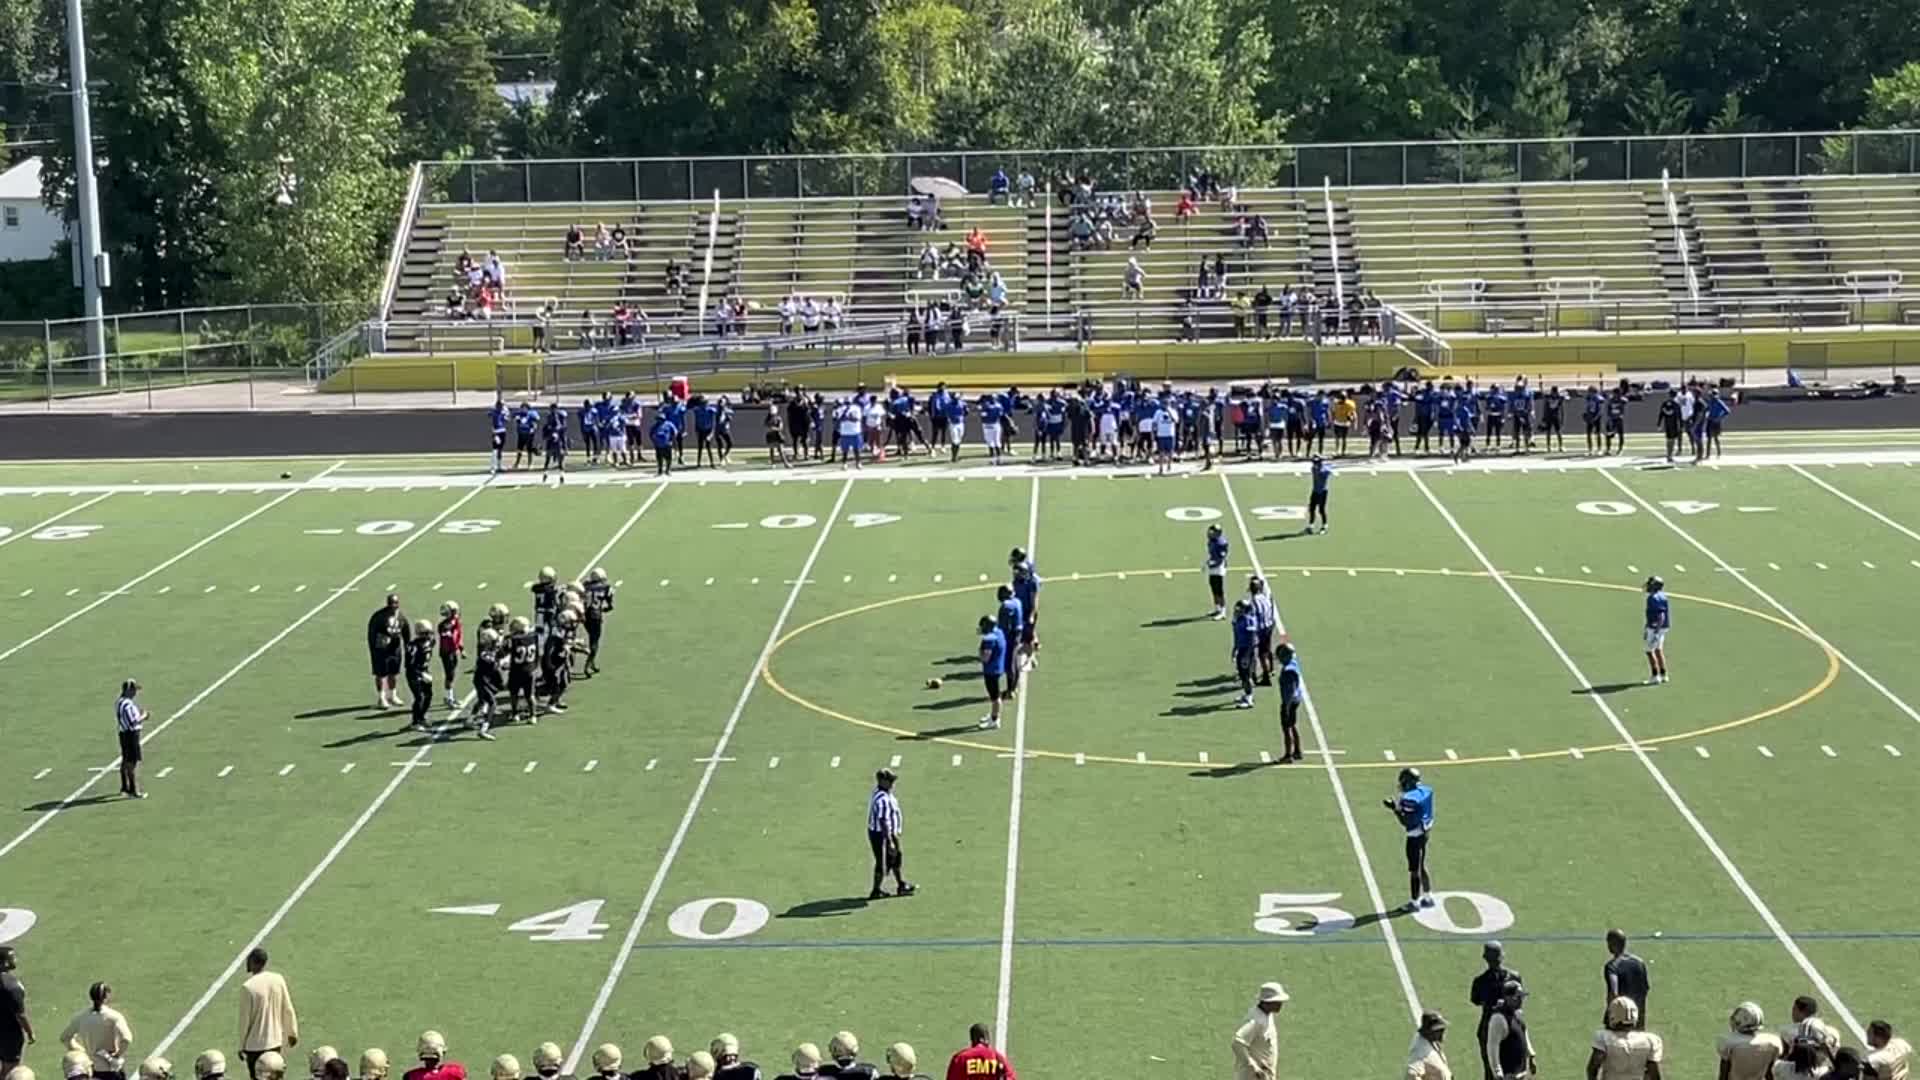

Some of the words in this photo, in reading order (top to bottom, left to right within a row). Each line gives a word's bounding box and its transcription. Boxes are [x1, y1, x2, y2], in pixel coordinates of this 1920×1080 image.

[507, 897, 769, 940] 40
[1254, 891, 1515, 936] 50
[966, 1058, 1004, 1075] EMT
